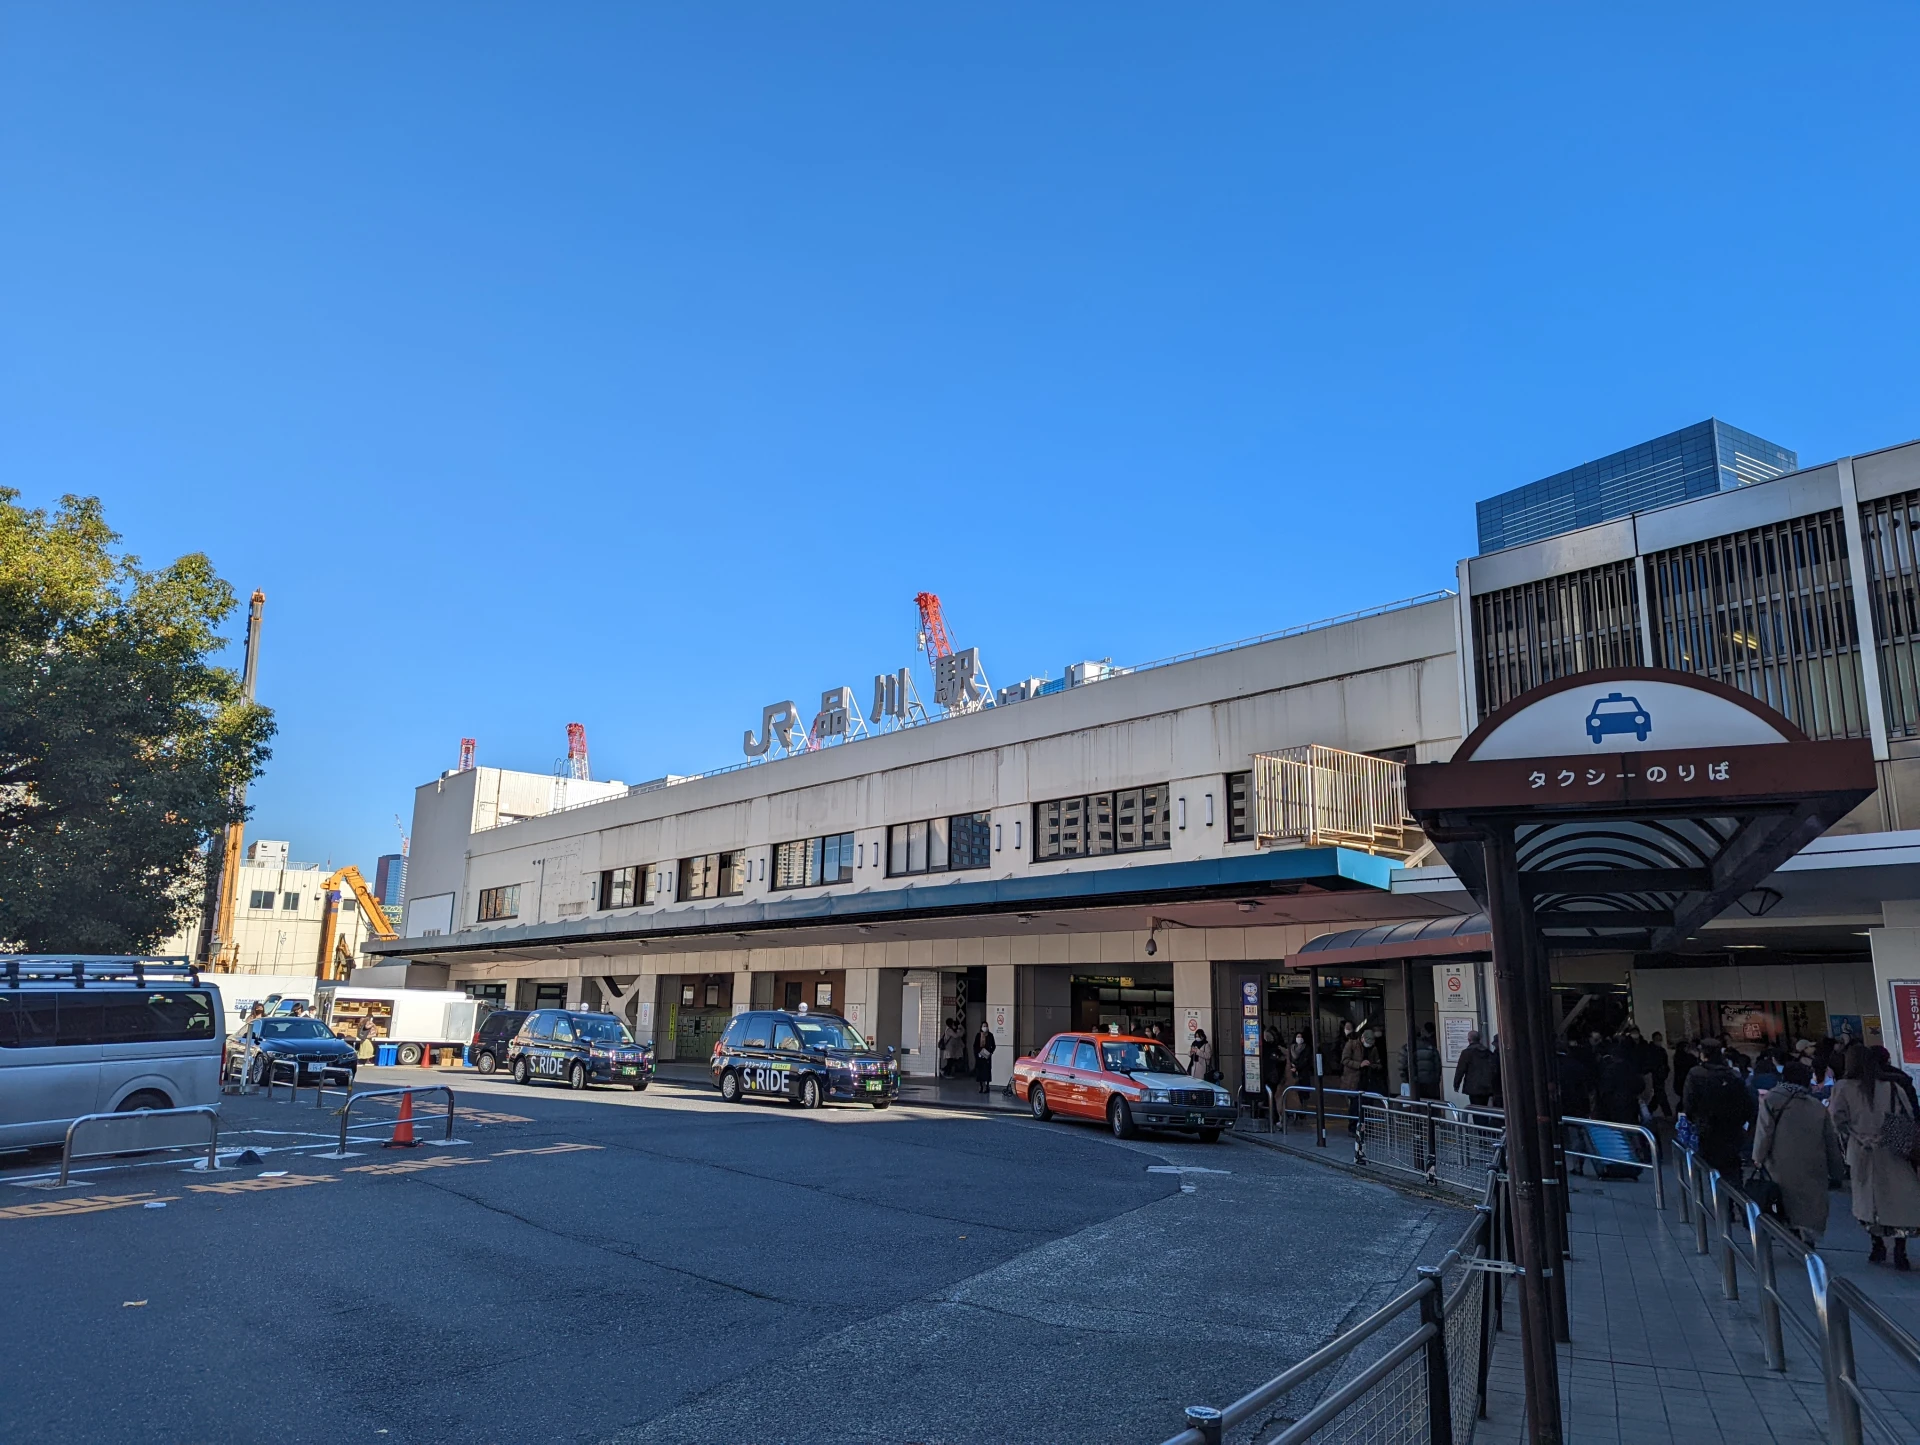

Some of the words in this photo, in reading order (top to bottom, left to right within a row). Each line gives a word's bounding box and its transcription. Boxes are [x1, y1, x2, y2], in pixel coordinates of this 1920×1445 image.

[743, 646, 981, 757] JR品川駅
[1528, 761, 1730, 789] タクシーのりば
[529, 1055, 564, 1076] S.RIDE
[743, 1068, 790, 1093] S.RIDE
